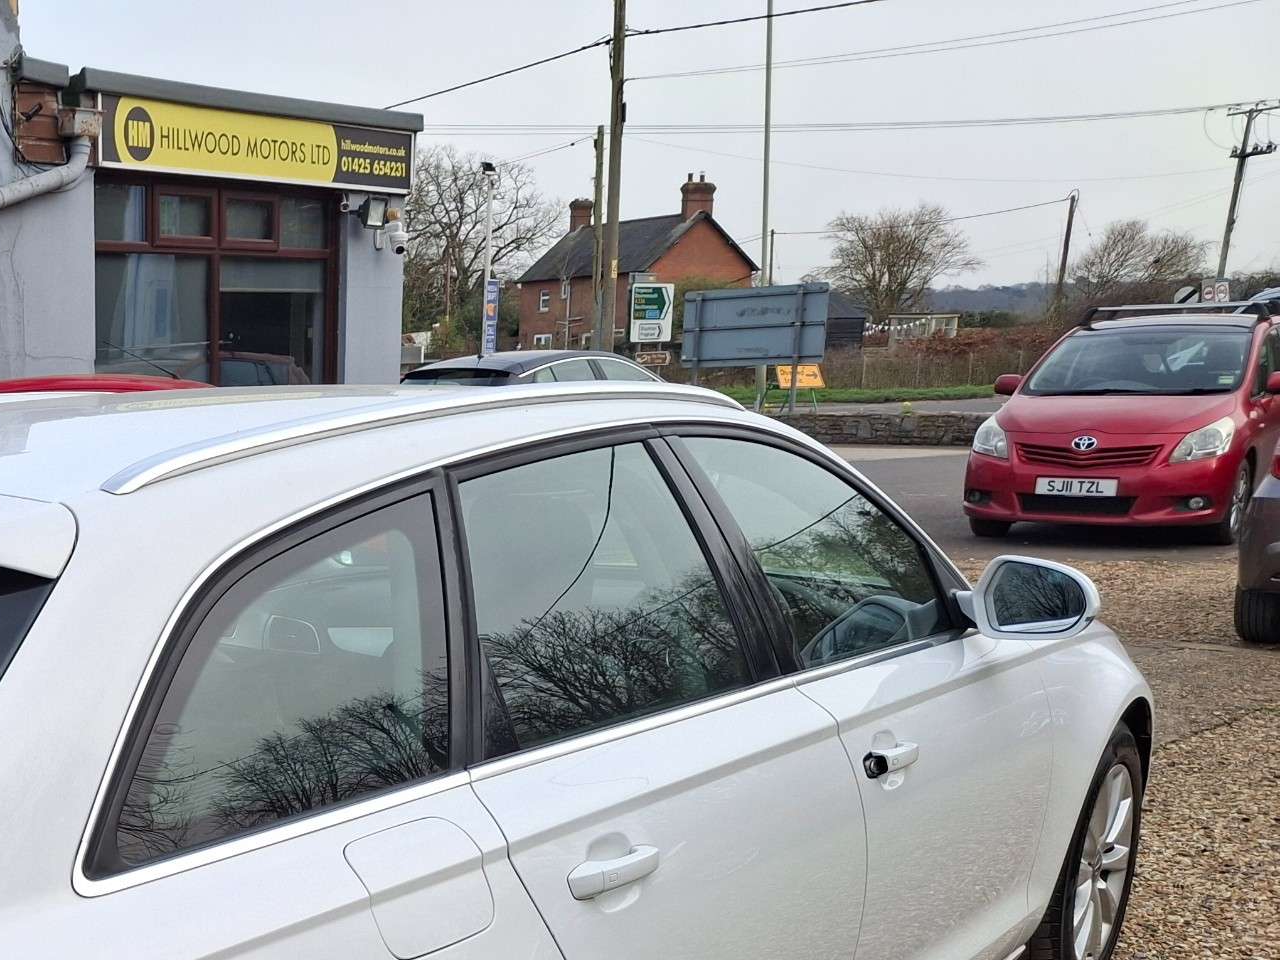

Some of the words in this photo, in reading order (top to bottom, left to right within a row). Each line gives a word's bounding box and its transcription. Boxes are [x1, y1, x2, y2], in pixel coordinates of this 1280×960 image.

[128, 120, 151, 149] HM
[160, 126, 241, 157] HILLWOOD
[246, 137, 306, 164] MOTORS
[310, 143, 331, 167] LTD
[341, 139, 406, 157] hillwoodmotors.co.uk
[341, 156, 371, 175] 01425
[373, 159, 406, 178] 654231
[1047, 480, 1073, 493] SJ11
[1077, 481, 1104, 494] TZL
